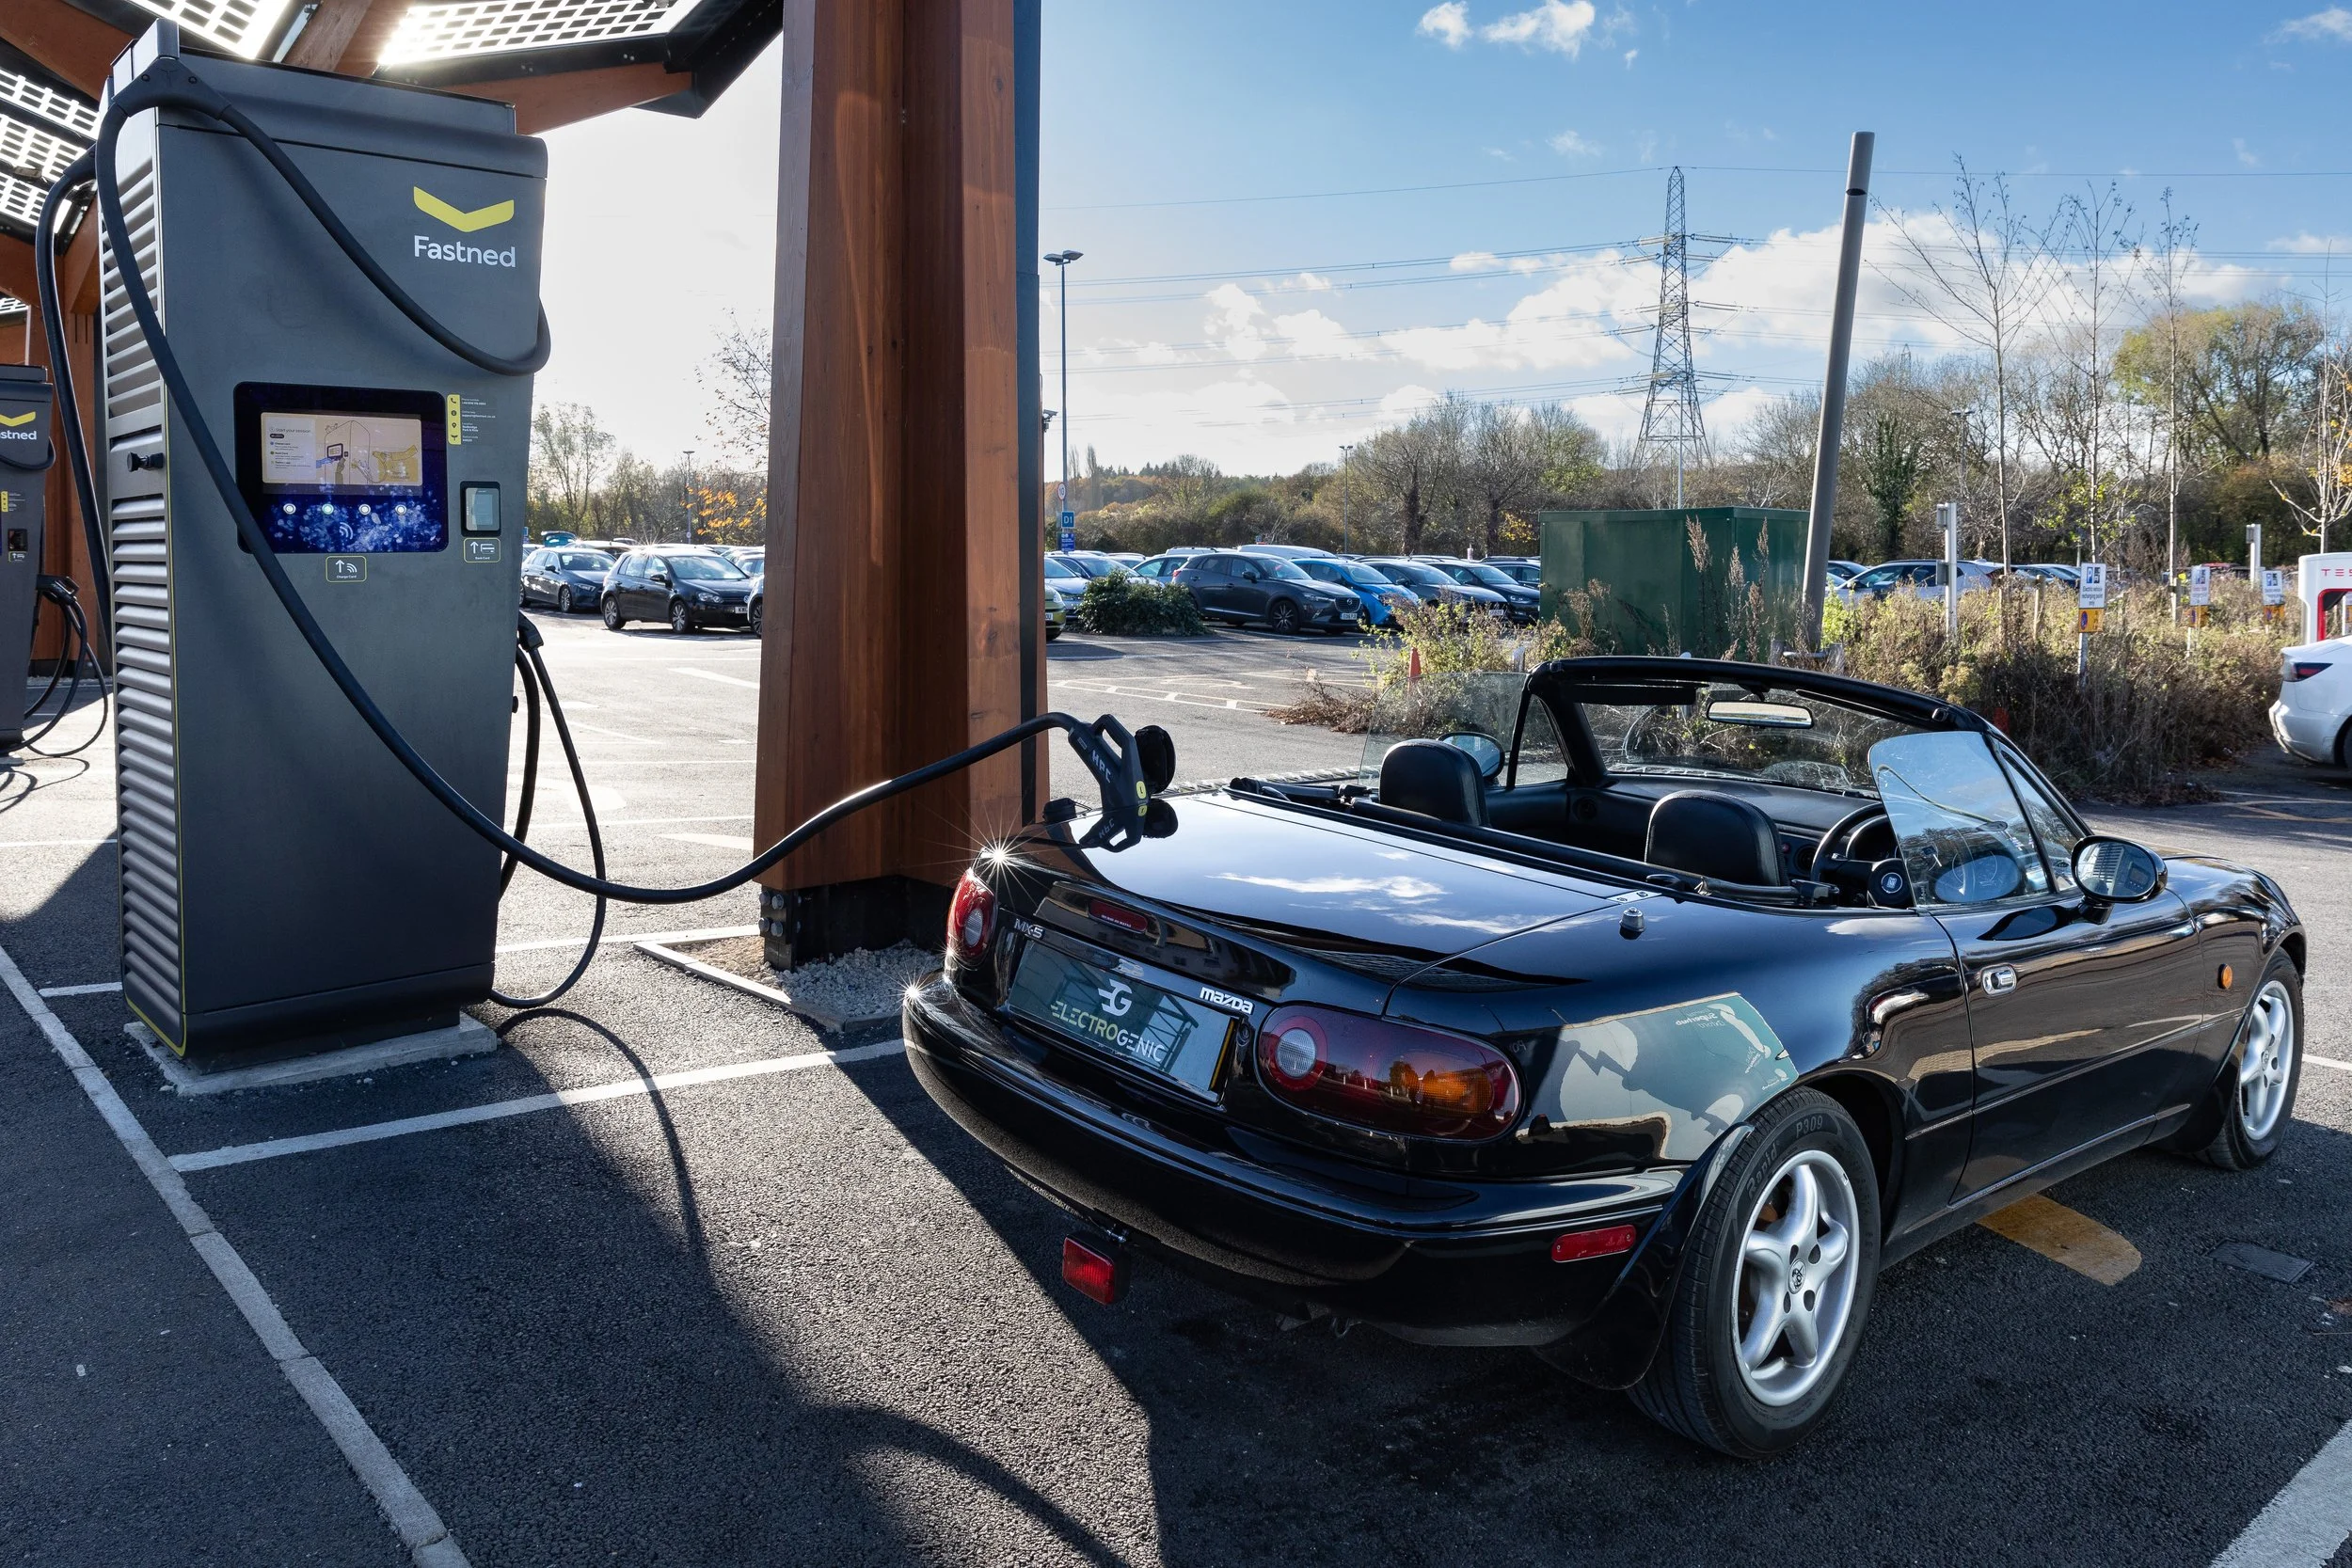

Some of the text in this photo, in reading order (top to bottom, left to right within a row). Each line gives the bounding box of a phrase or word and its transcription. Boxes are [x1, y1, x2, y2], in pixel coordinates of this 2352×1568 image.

[414, 235, 516, 267] Fastned
[1063, 515, 1073, 524] D1
[1014, 918, 1043, 939] MX-5
[1050, 1000, 1168, 1063] ELECTROGENIC
[1796, 1115, 1823, 1138] P309
